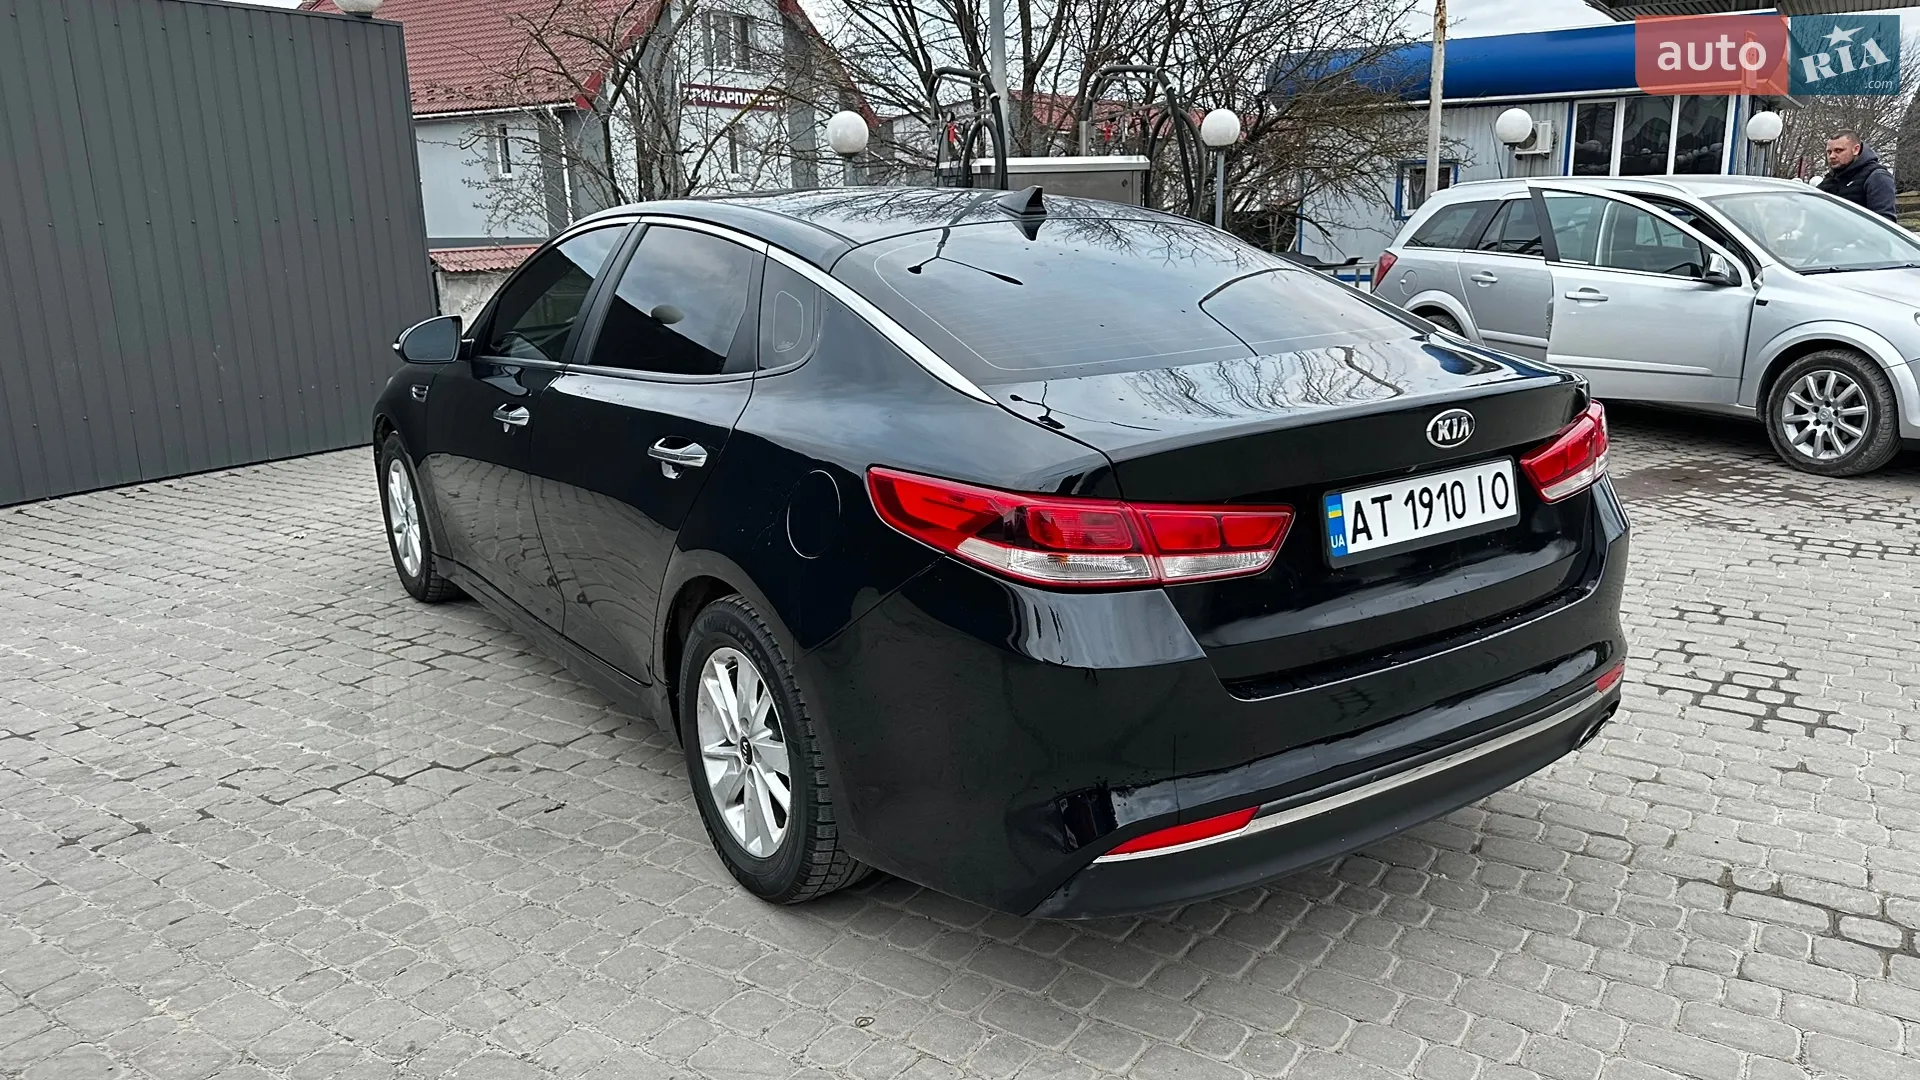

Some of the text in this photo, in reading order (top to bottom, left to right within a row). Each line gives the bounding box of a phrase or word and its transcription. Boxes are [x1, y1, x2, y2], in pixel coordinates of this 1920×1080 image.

[1437, 416, 1470, 442] KIA
[1351, 471, 1509, 545] AT 1910 IO
[1331, 535, 1346, 549] UA
